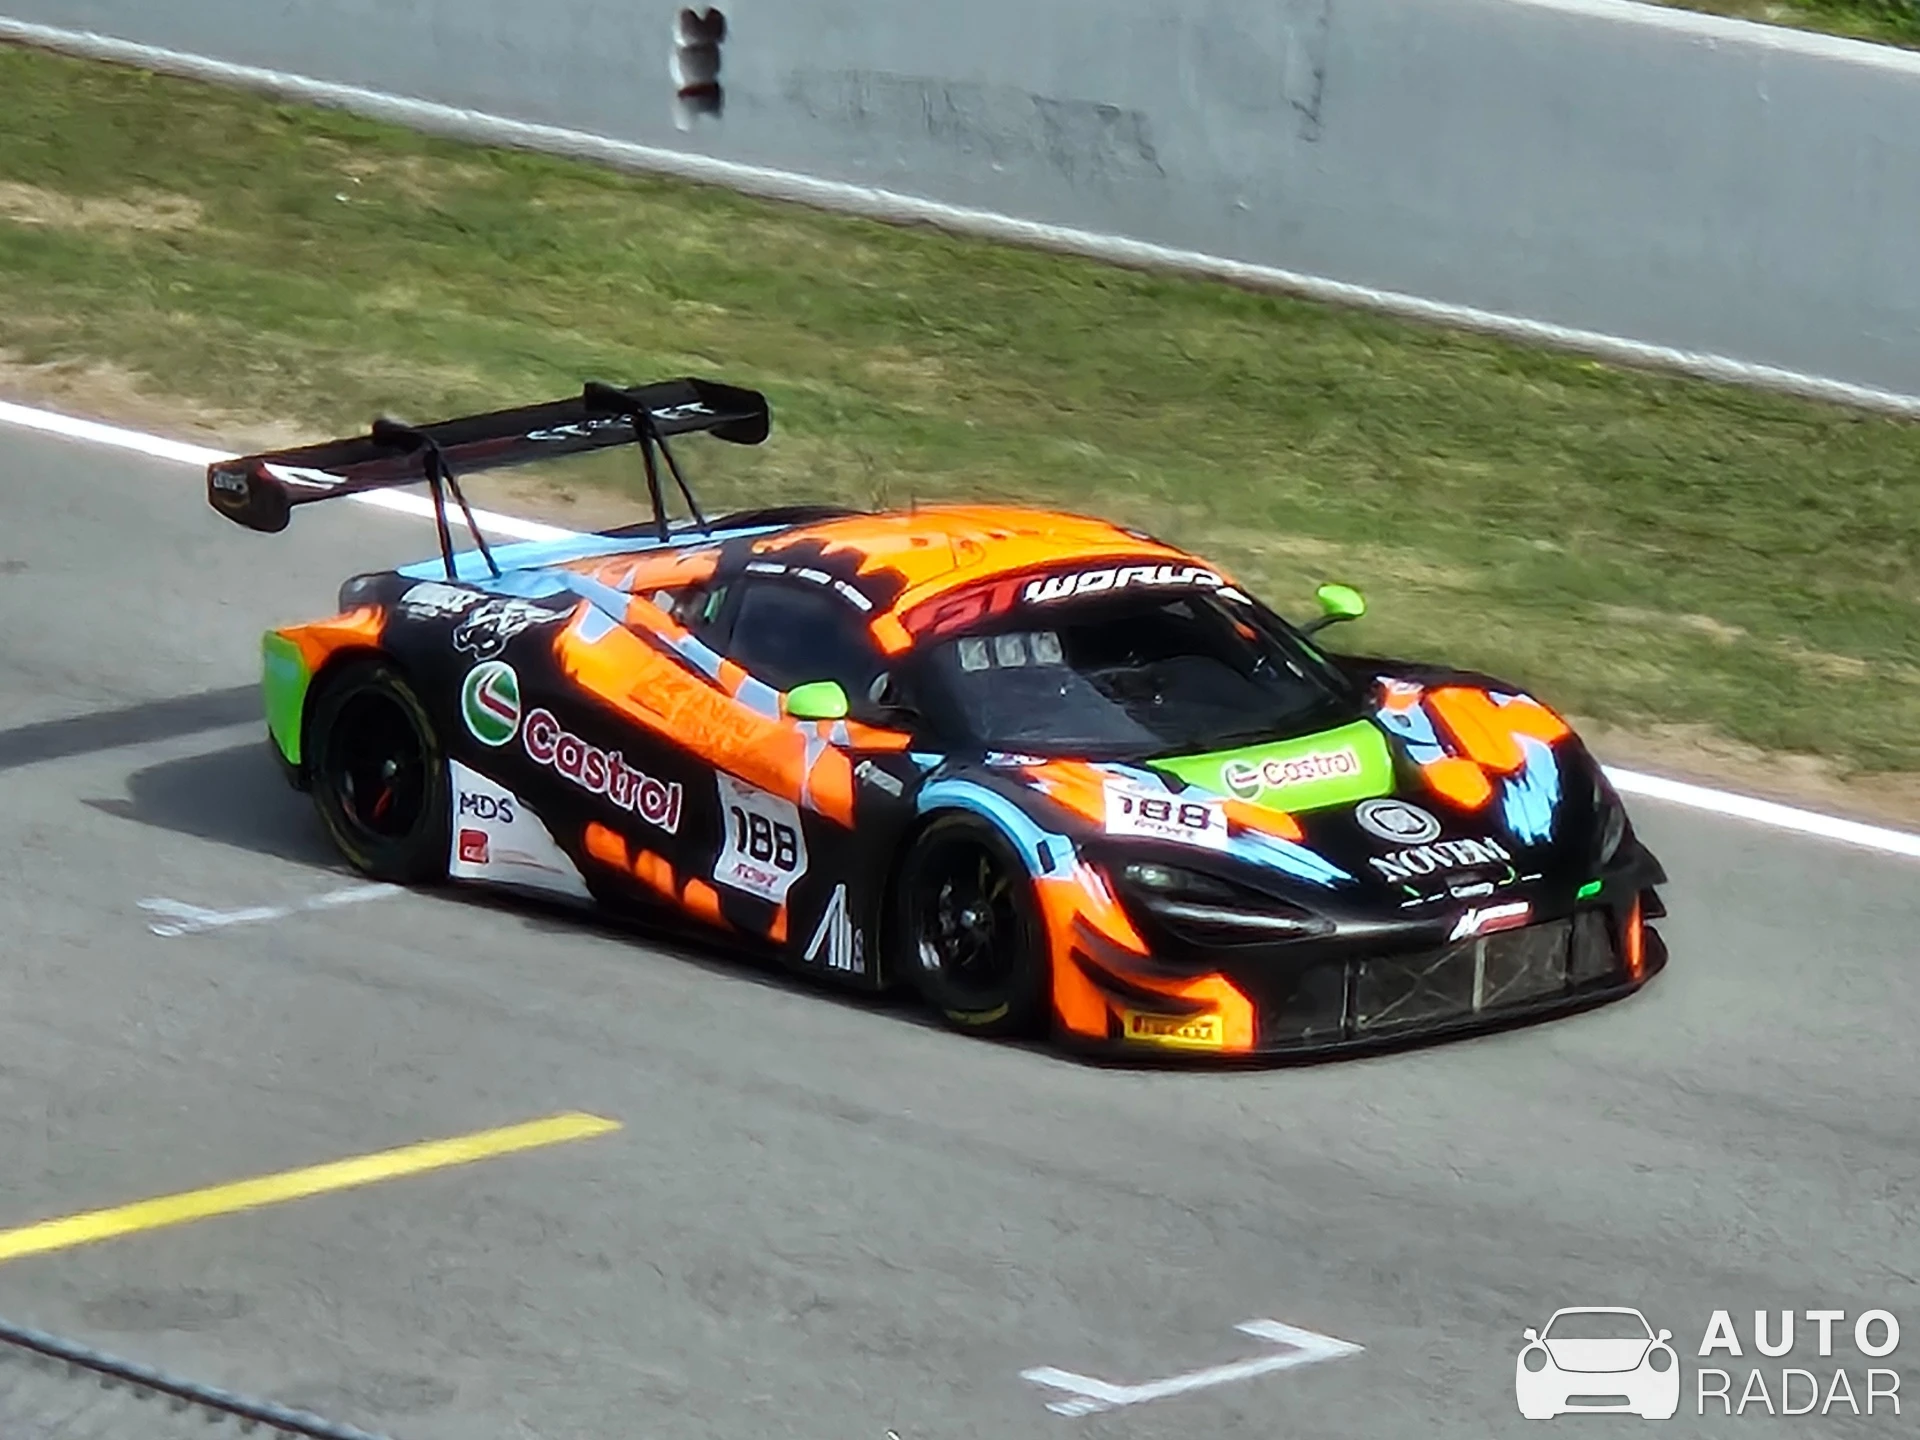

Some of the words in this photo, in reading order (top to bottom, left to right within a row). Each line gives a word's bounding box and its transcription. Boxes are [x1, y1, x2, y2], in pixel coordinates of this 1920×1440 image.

[523, 708, 683, 835] Castrol
[1263, 750, 1358, 785] Castrol
[460, 792, 514, 824] MDS
[1118, 796, 1211, 831] 188
[730, 804, 798, 873] 188
[1368, 836, 1511, 884] NOVEM
